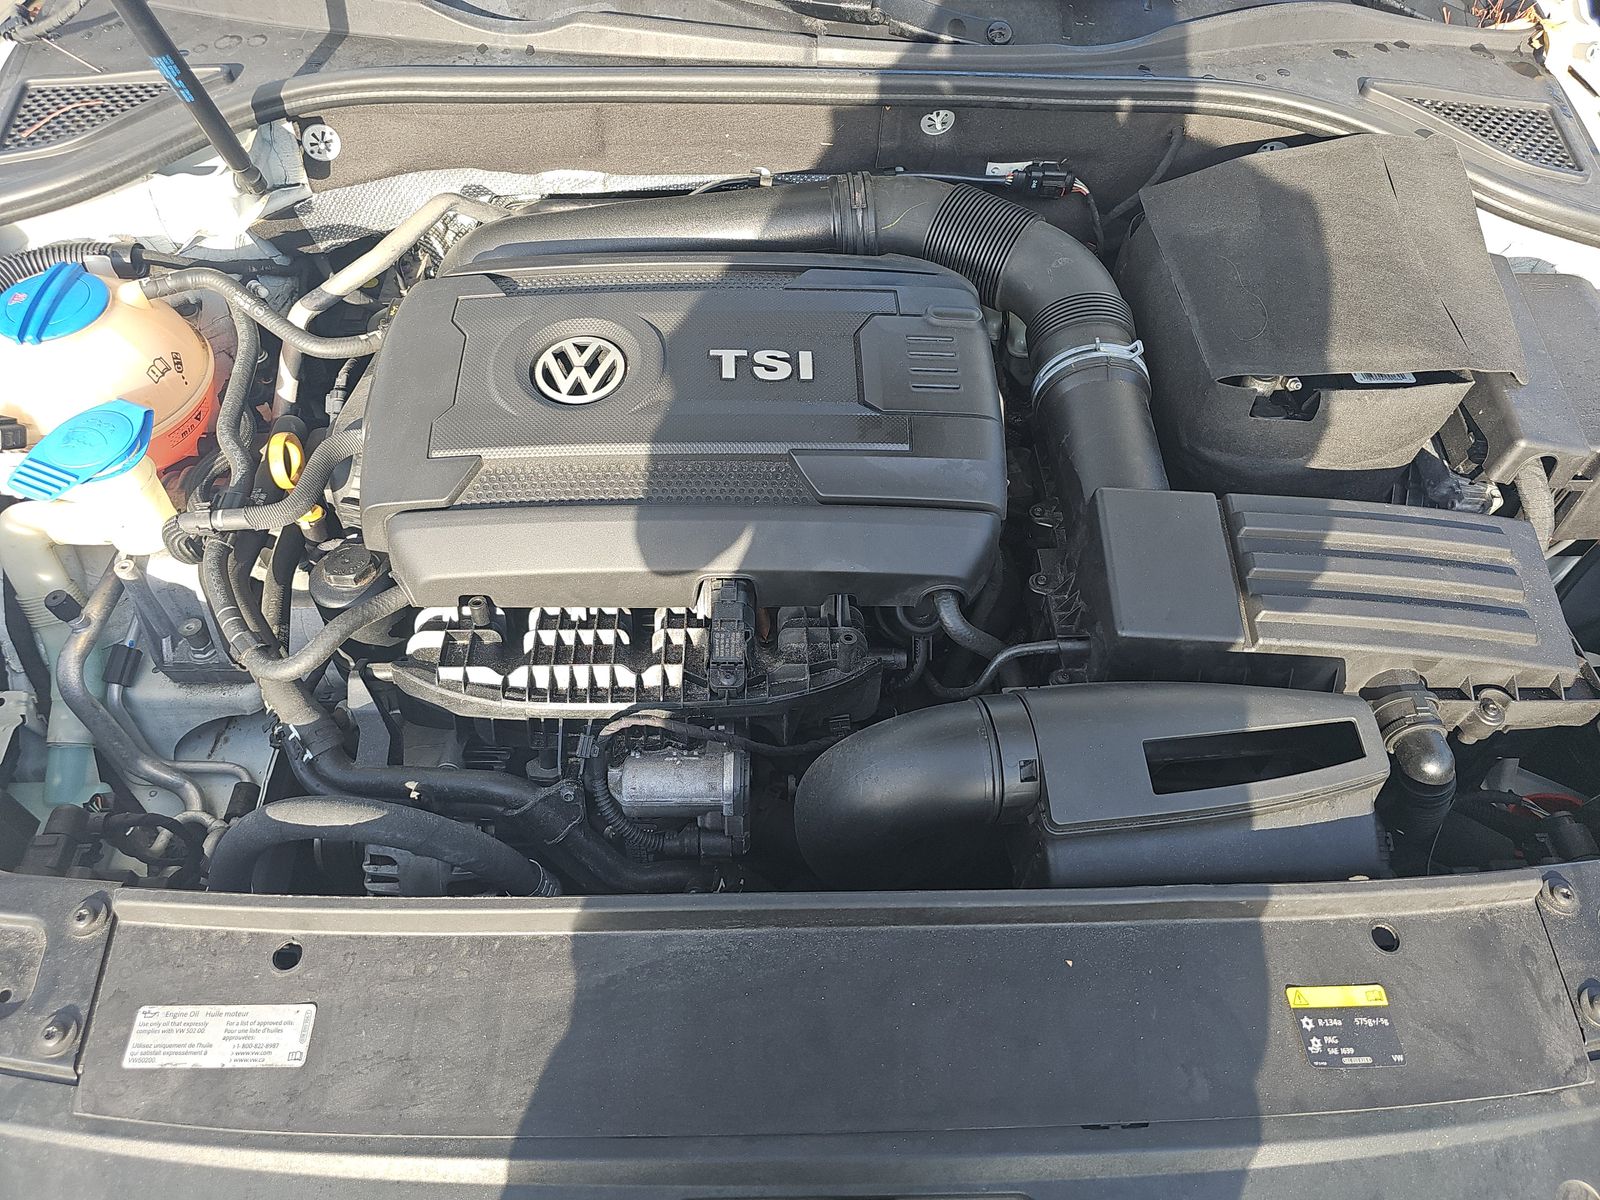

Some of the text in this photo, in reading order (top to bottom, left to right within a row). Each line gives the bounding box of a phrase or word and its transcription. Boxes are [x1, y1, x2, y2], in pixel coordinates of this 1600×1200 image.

[708, 349, 814, 381] TSI
[534, 335, 627, 405] VW
[181, 422, 195, 438] min
[165, 1010, 200, 1019] Engine Oil
[205, 1010, 223, 1018] Huile
[150, 1021, 161, 1029] only
[183, 1021, 209, 1029] expressly
[257, 1020, 283, 1028] approved
[1317, 1018, 1342, 1027] R-134a
[136, 1028, 161, 1036] complies
[1323, 1036, 1339, 1045] PAG
[153, 1042, 187, 1050] uniquement
